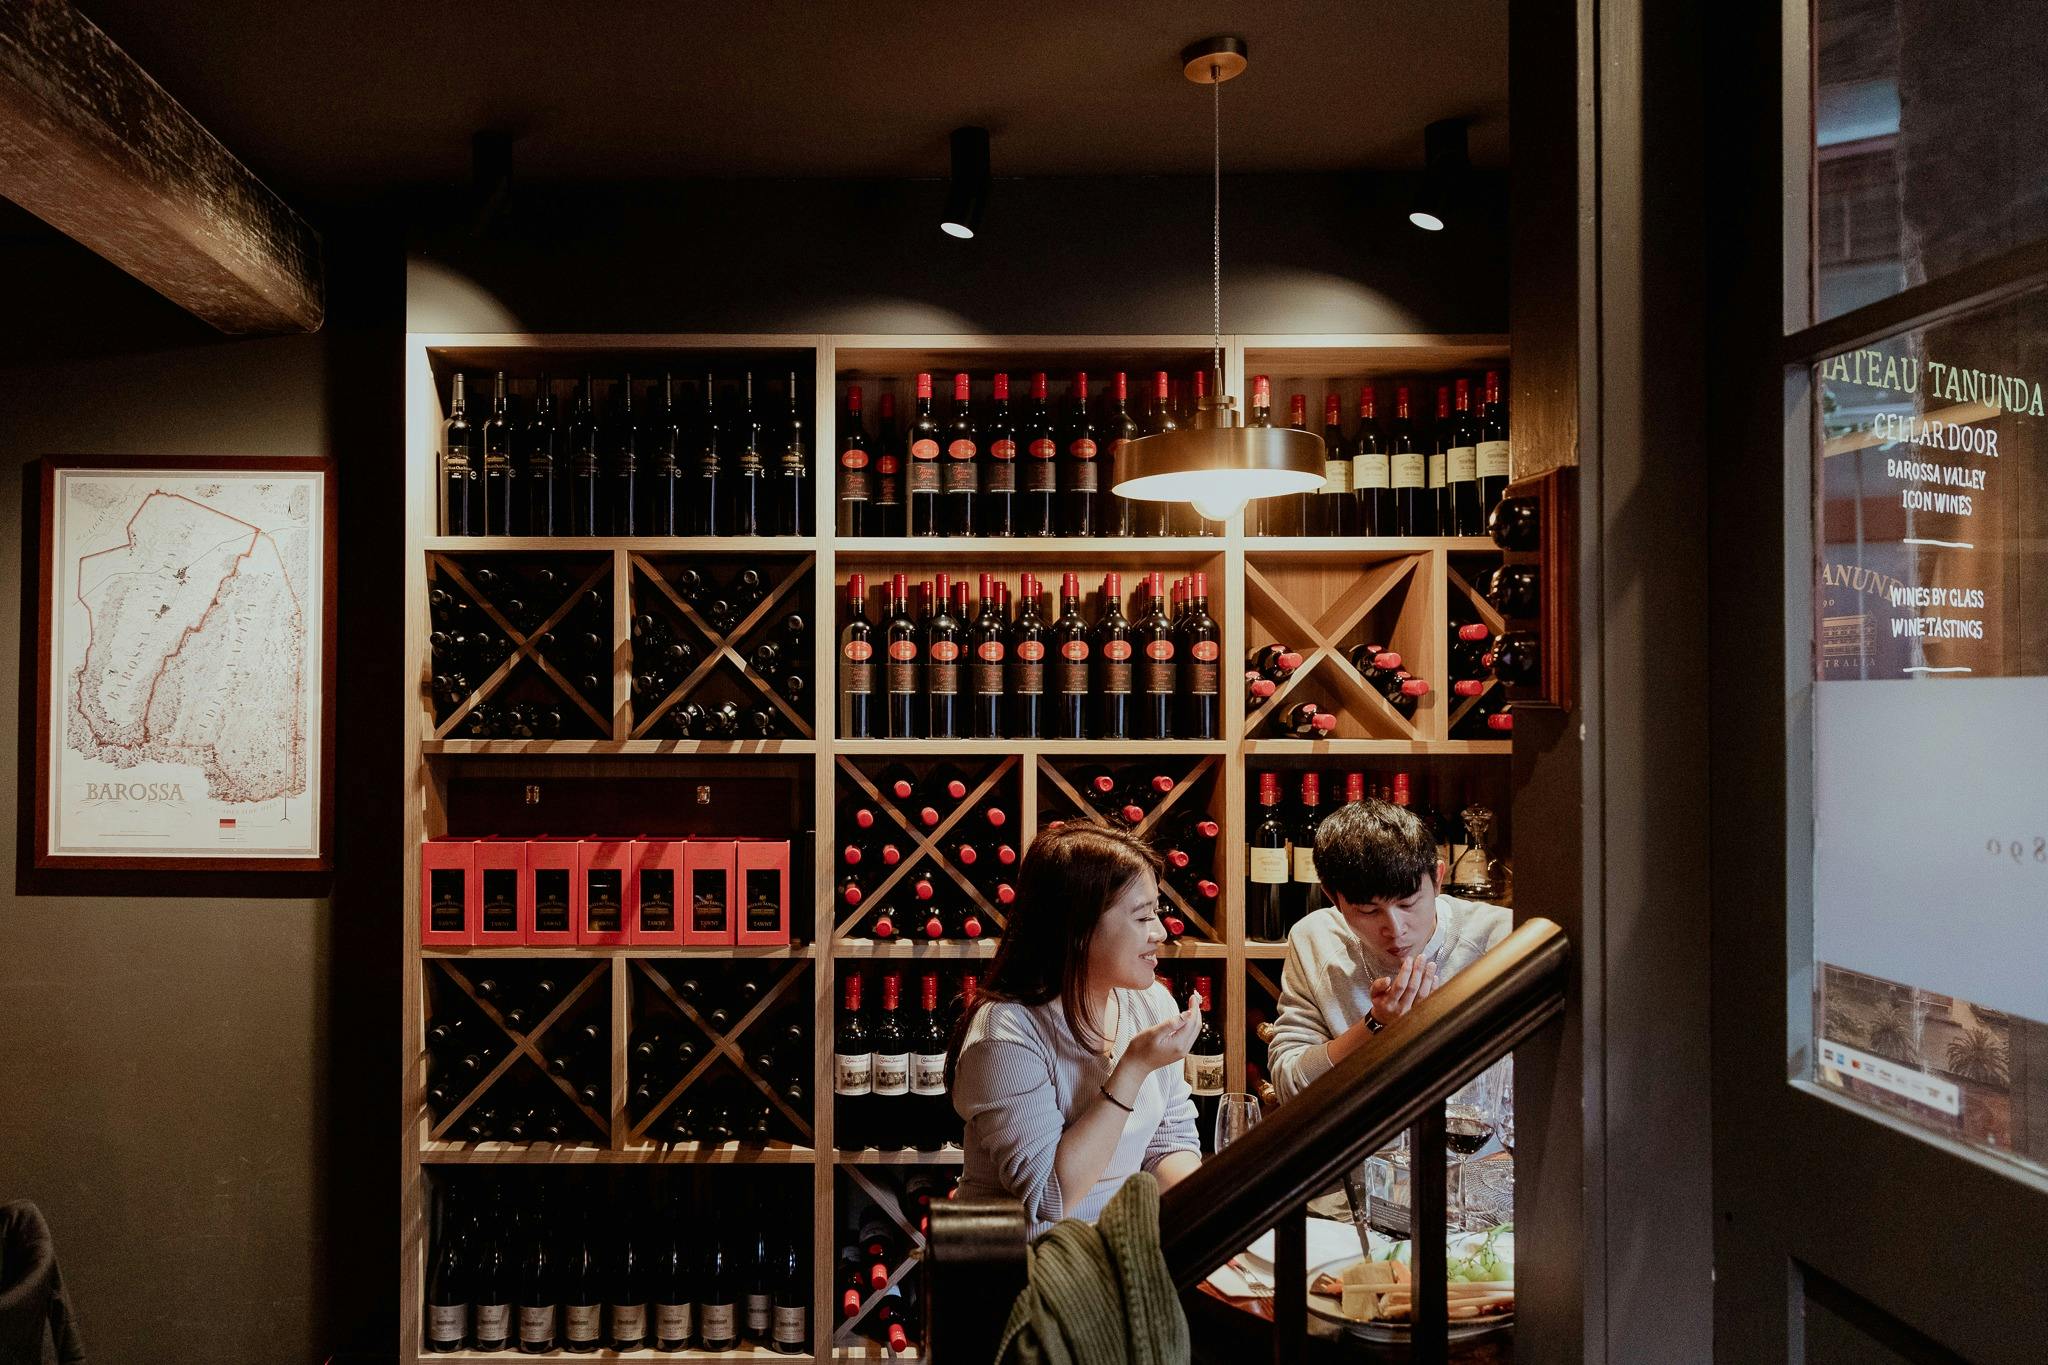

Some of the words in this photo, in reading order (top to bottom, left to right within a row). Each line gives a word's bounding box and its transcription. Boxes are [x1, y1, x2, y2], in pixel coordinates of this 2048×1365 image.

[1928, 361, 2045, 417] TANUNDA
[1874, 412, 1945, 449] CELLAR
[1948, 423, 1999, 458] DOOR
[1887, 459, 1941, 484] BAROSSA
[1943, 466, 1986, 491] VALLEY
[1902, 489, 1932, 512] ICON
[1933, 493, 1973, 517] WINES
[1889, 585, 1930, 608] WINES
[1931, 588, 1947, 606] BY
[1949, 588, 1985, 609] GLASS
[1891, 617, 1925, 638] WINE
[1926, 617, 1983, 640] TASTINGS
[86, 782, 185, 801] BAROSSA
